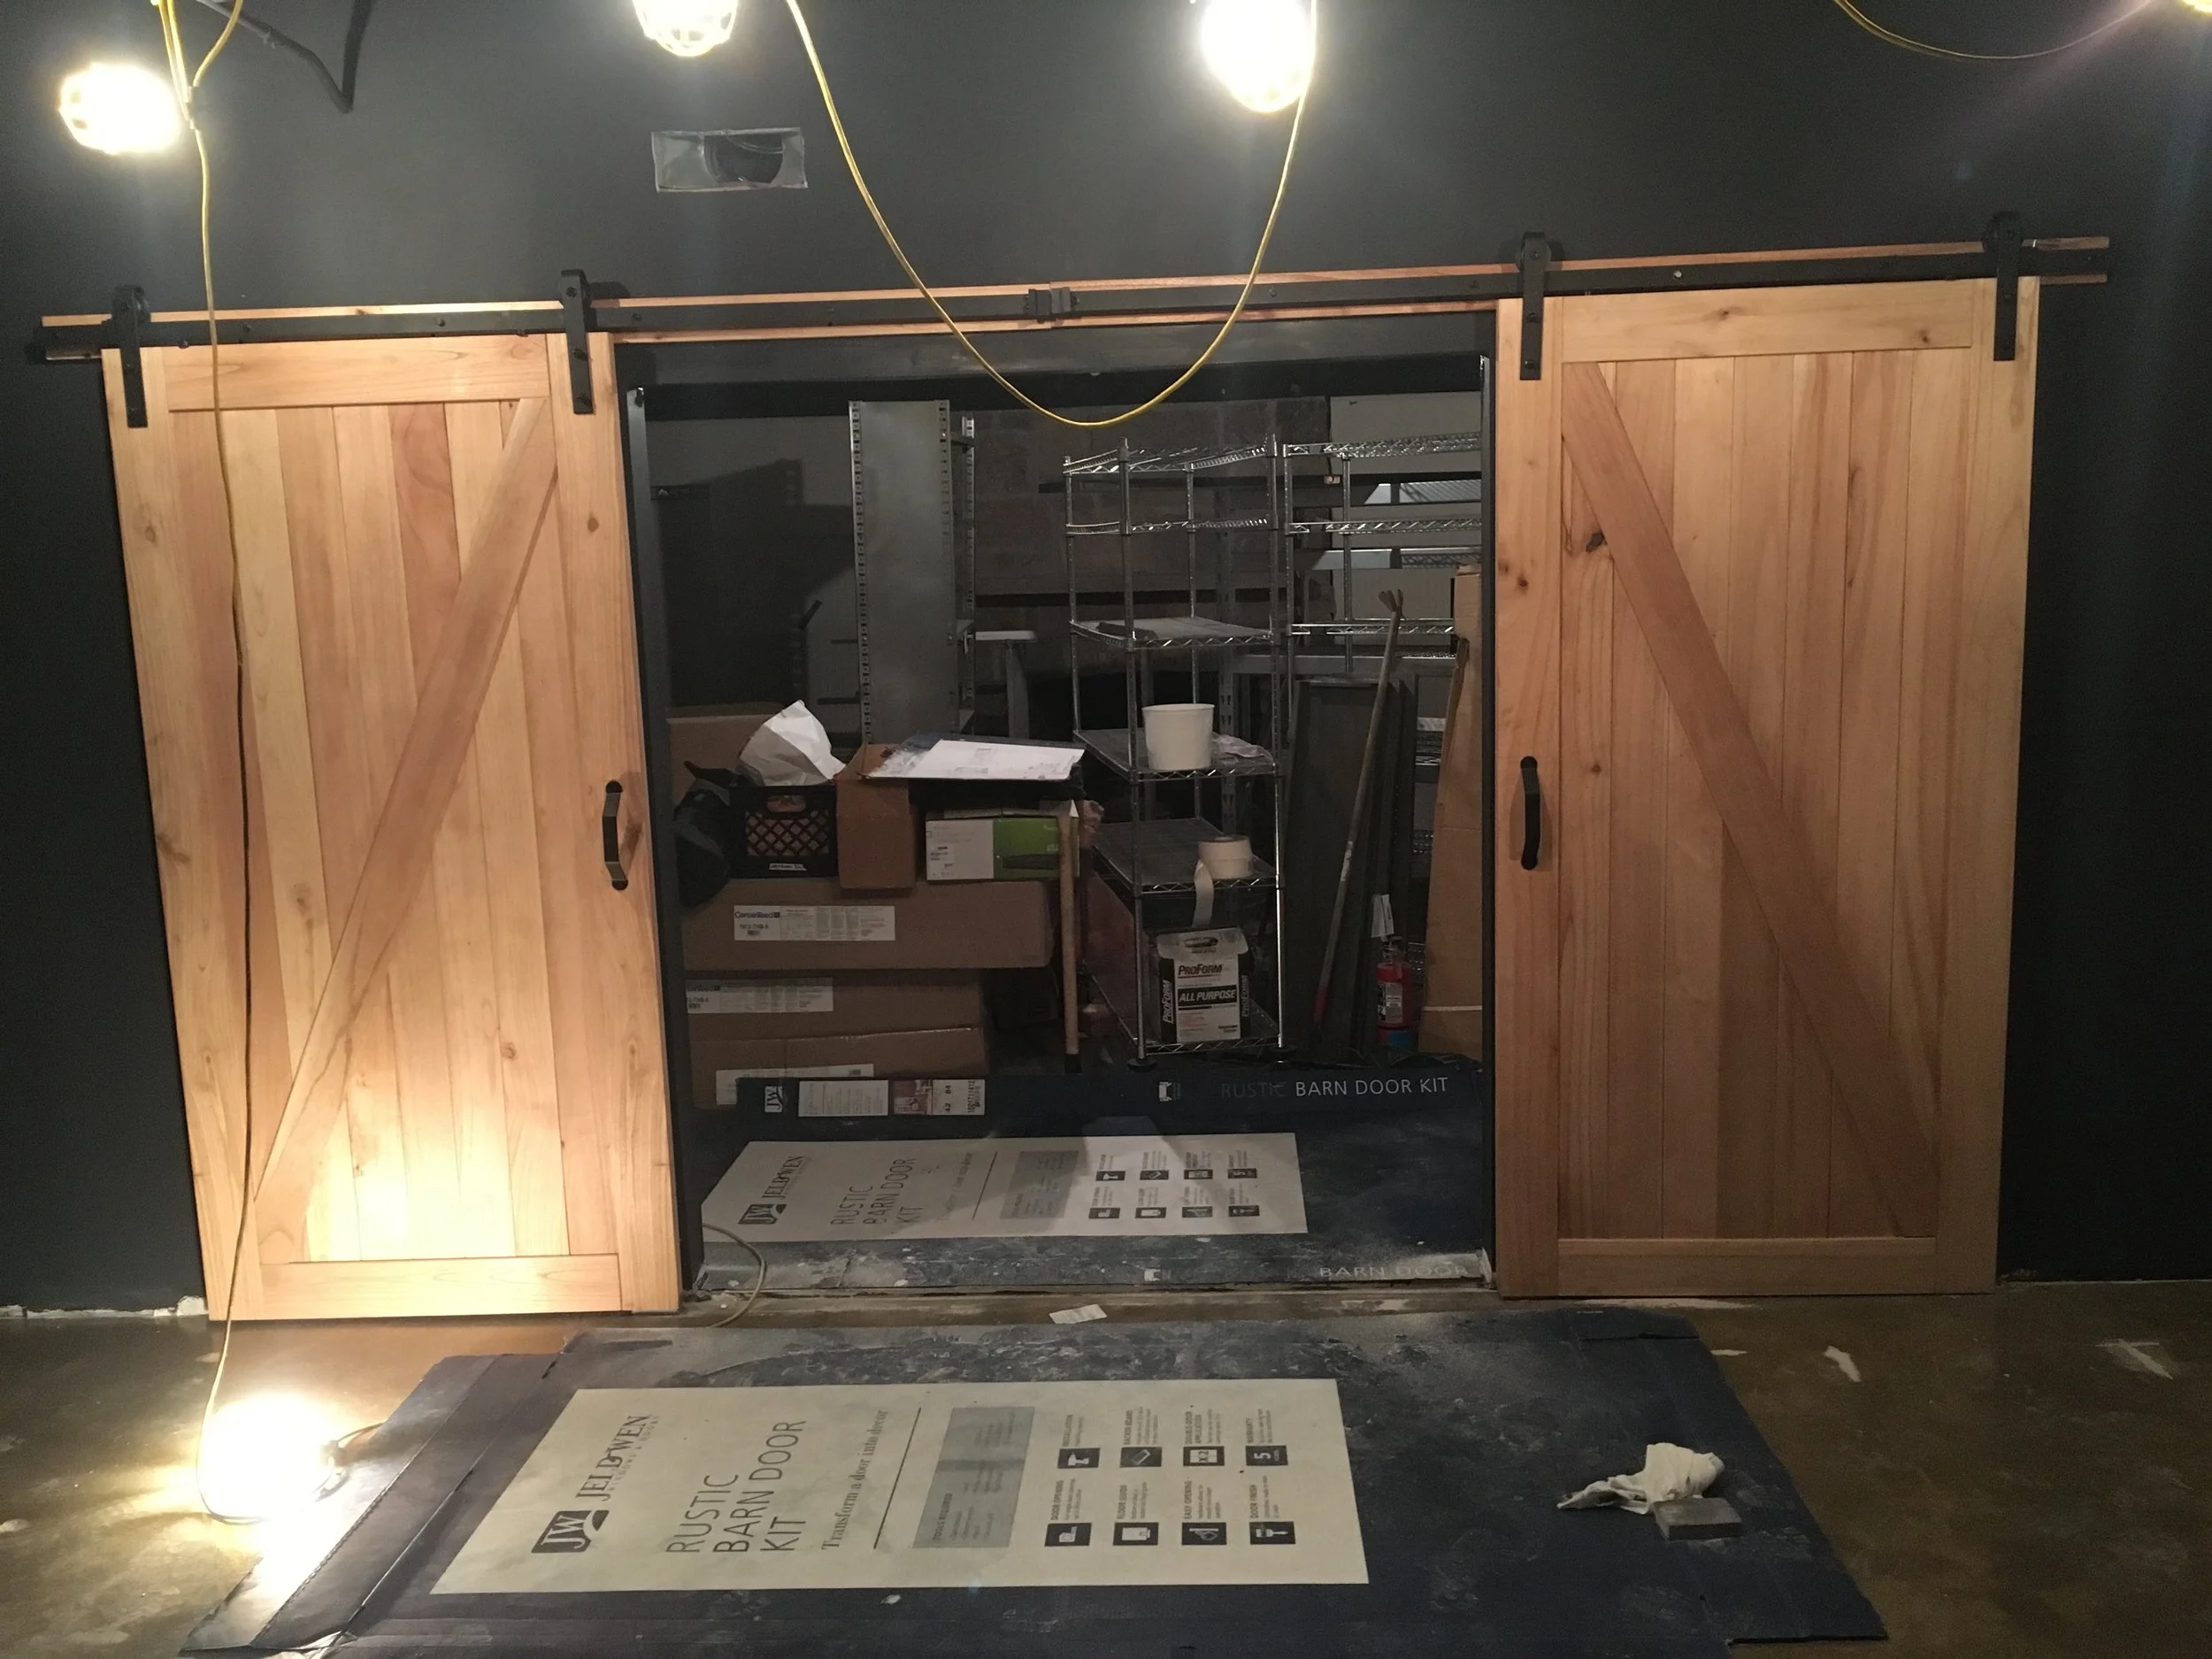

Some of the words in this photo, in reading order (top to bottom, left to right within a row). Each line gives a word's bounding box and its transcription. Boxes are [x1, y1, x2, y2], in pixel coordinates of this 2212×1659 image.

[1179, 992, 1195, 1002] ALL
[1195, 988, 1236, 1002] PURPOSE
[1220, 1080, 1286, 1099] RUSTIC
[1295, 1079, 1348, 1097] BARN
[1356, 1078, 1412, 1095] DOOR
[1419, 1077, 1448, 1094] KIT
[880, 1157, 916, 1190] DOOR
[830, 1186, 873, 1225] RUSTIC
[863, 1192, 900, 1225] BARN
[895, 1205, 924, 1224] KIT
[1319, 1265, 1386, 1278] BARN
[1395, 1264, 1469, 1277] DOOR
[865, 1410, 887, 1435] decor
[857, 1436, 879, 1456] into
[1253, 1451, 1271, 1460] 5
[846, 1458, 871, 1481] door
[713, 1491, 775, 1553] BARN
[749, 1420, 807, 1481] DOOR
[665, 1474, 739, 1553] RUSTIC
[821, 1492, 861, 1550] Transform
[1183, 1504, 1193, 1520] EASY
[541, 1515, 585, 1549] JW
[760, 1517, 807, 1552] KIT
